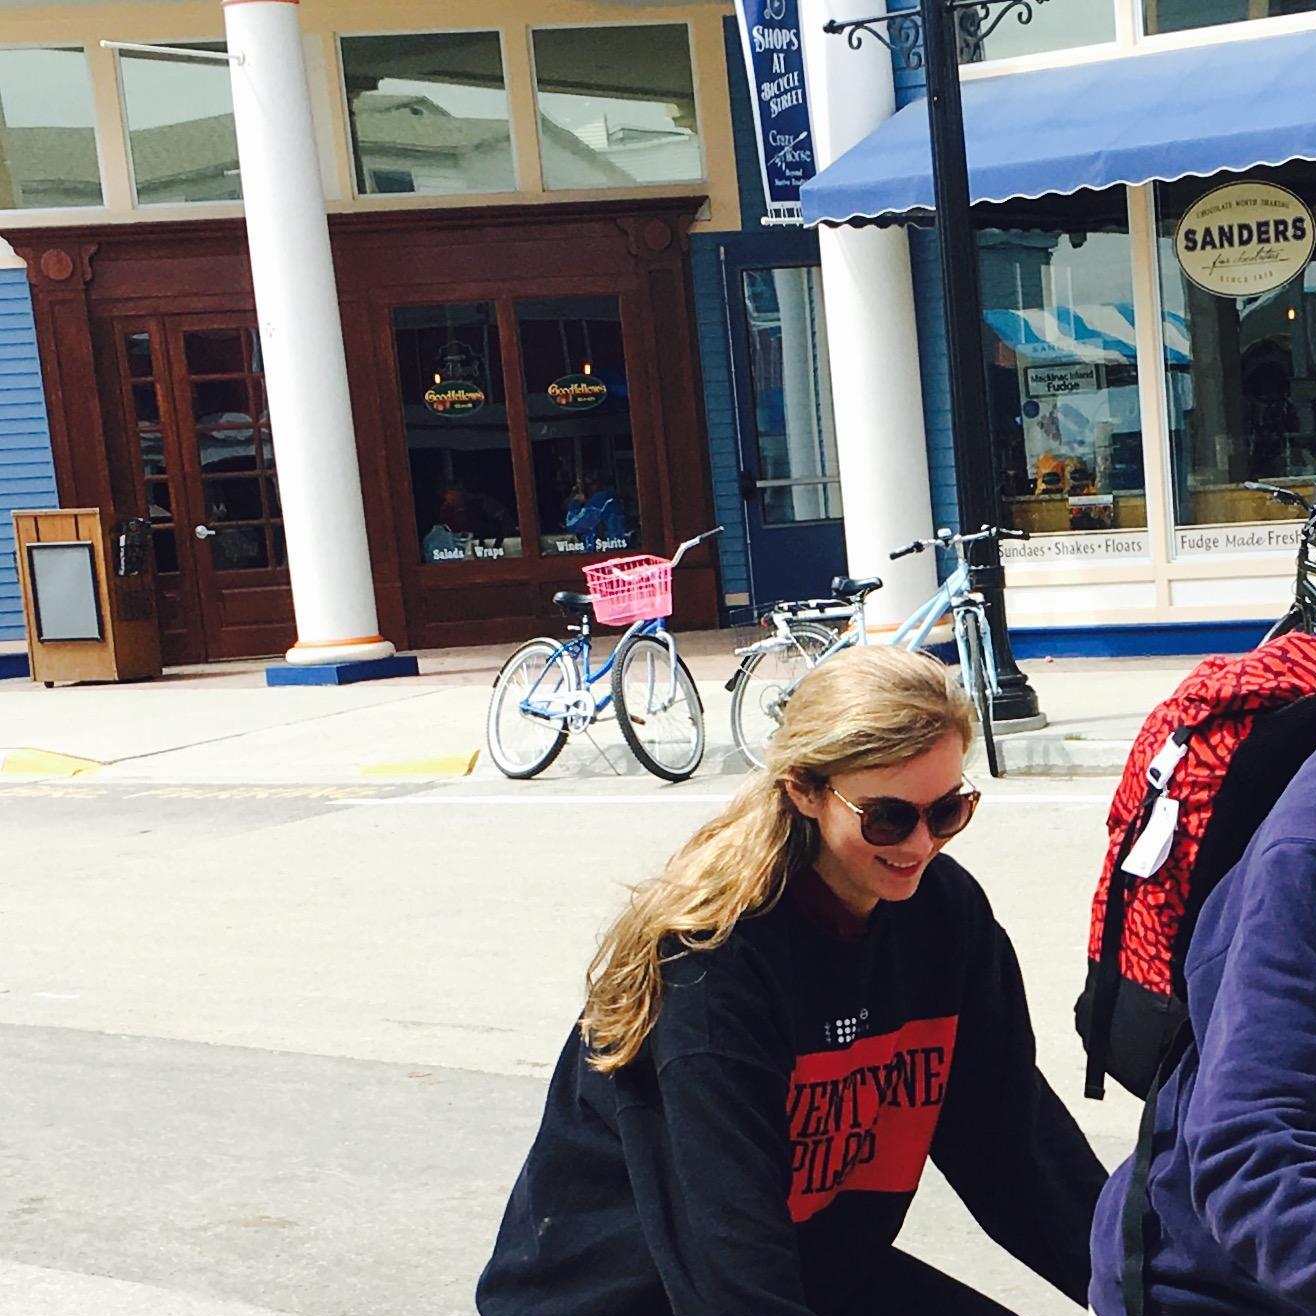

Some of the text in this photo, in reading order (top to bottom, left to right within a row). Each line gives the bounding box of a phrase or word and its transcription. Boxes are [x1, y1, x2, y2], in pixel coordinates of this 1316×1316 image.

[752, 25, 799, 52] SHOPS
[772, 52, 785, 74] AT
[761, 71, 799, 101] BICYCLE
[769, 88, 803, 118] STREET
[1183, 216, 1306, 252] SANDERS
[1046, 381, 1080, 393] Fudge
[556, 537, 627, 552] Wines Spirits
[999, 538, 1142, 558] Sundaes Shakes Floats
[1180, 534, 1219, 551] Fudge
[1225, 532, 1263, 547] Made
[433, 546, 504, 560] Salads Wraps
